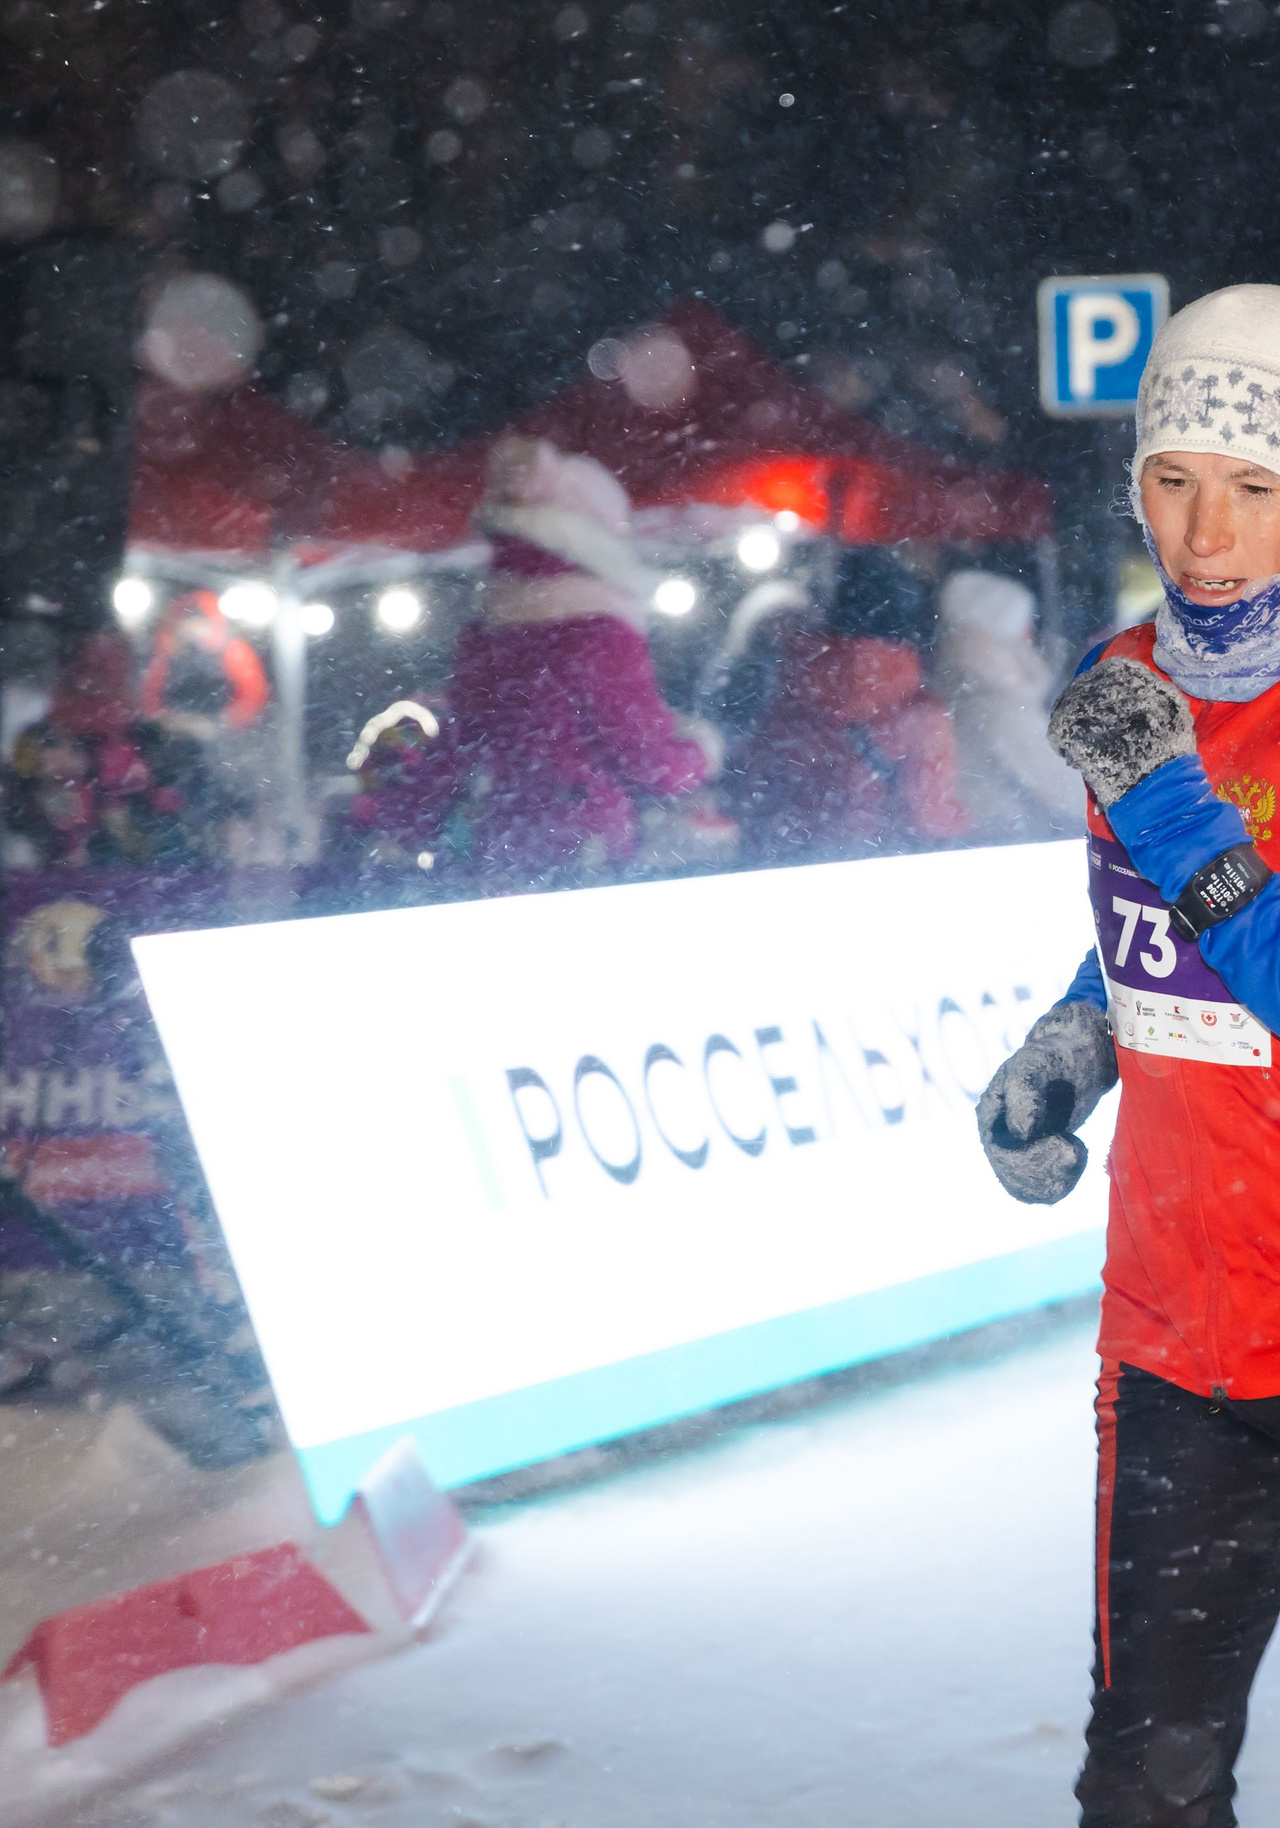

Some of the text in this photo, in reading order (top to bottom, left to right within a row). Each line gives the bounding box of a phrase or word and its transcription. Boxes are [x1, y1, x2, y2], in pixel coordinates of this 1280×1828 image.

[1067, 294, 1140, 396] P
[1200, 890, 1216, 908] POLAR
[1206, 884, 1223, 903] 17:04
[1112, 896, 1177, 978] 73
